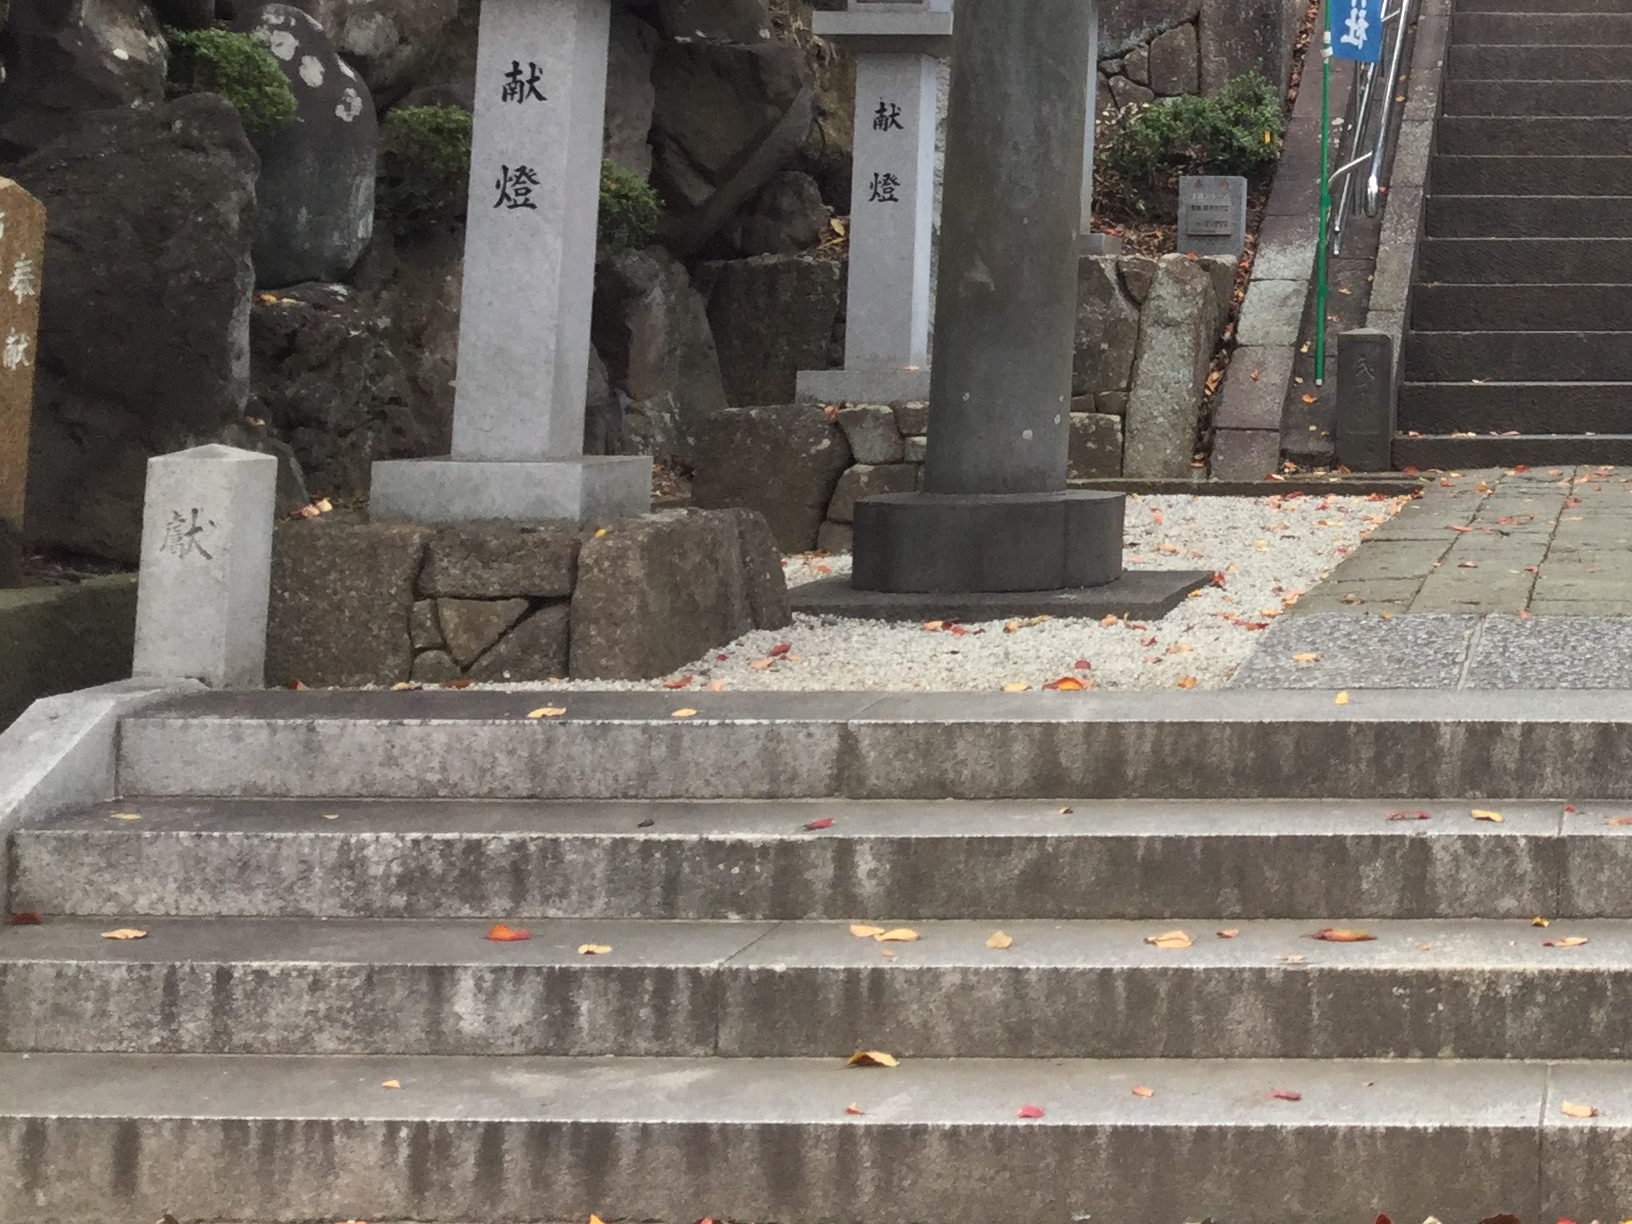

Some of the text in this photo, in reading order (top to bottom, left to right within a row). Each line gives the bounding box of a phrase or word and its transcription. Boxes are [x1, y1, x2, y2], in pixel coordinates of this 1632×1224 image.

[492, 60, 548, 210] 献燈
[868, 100, 905, 203] 献燈
[3, 252, 36, 371] 奉献
